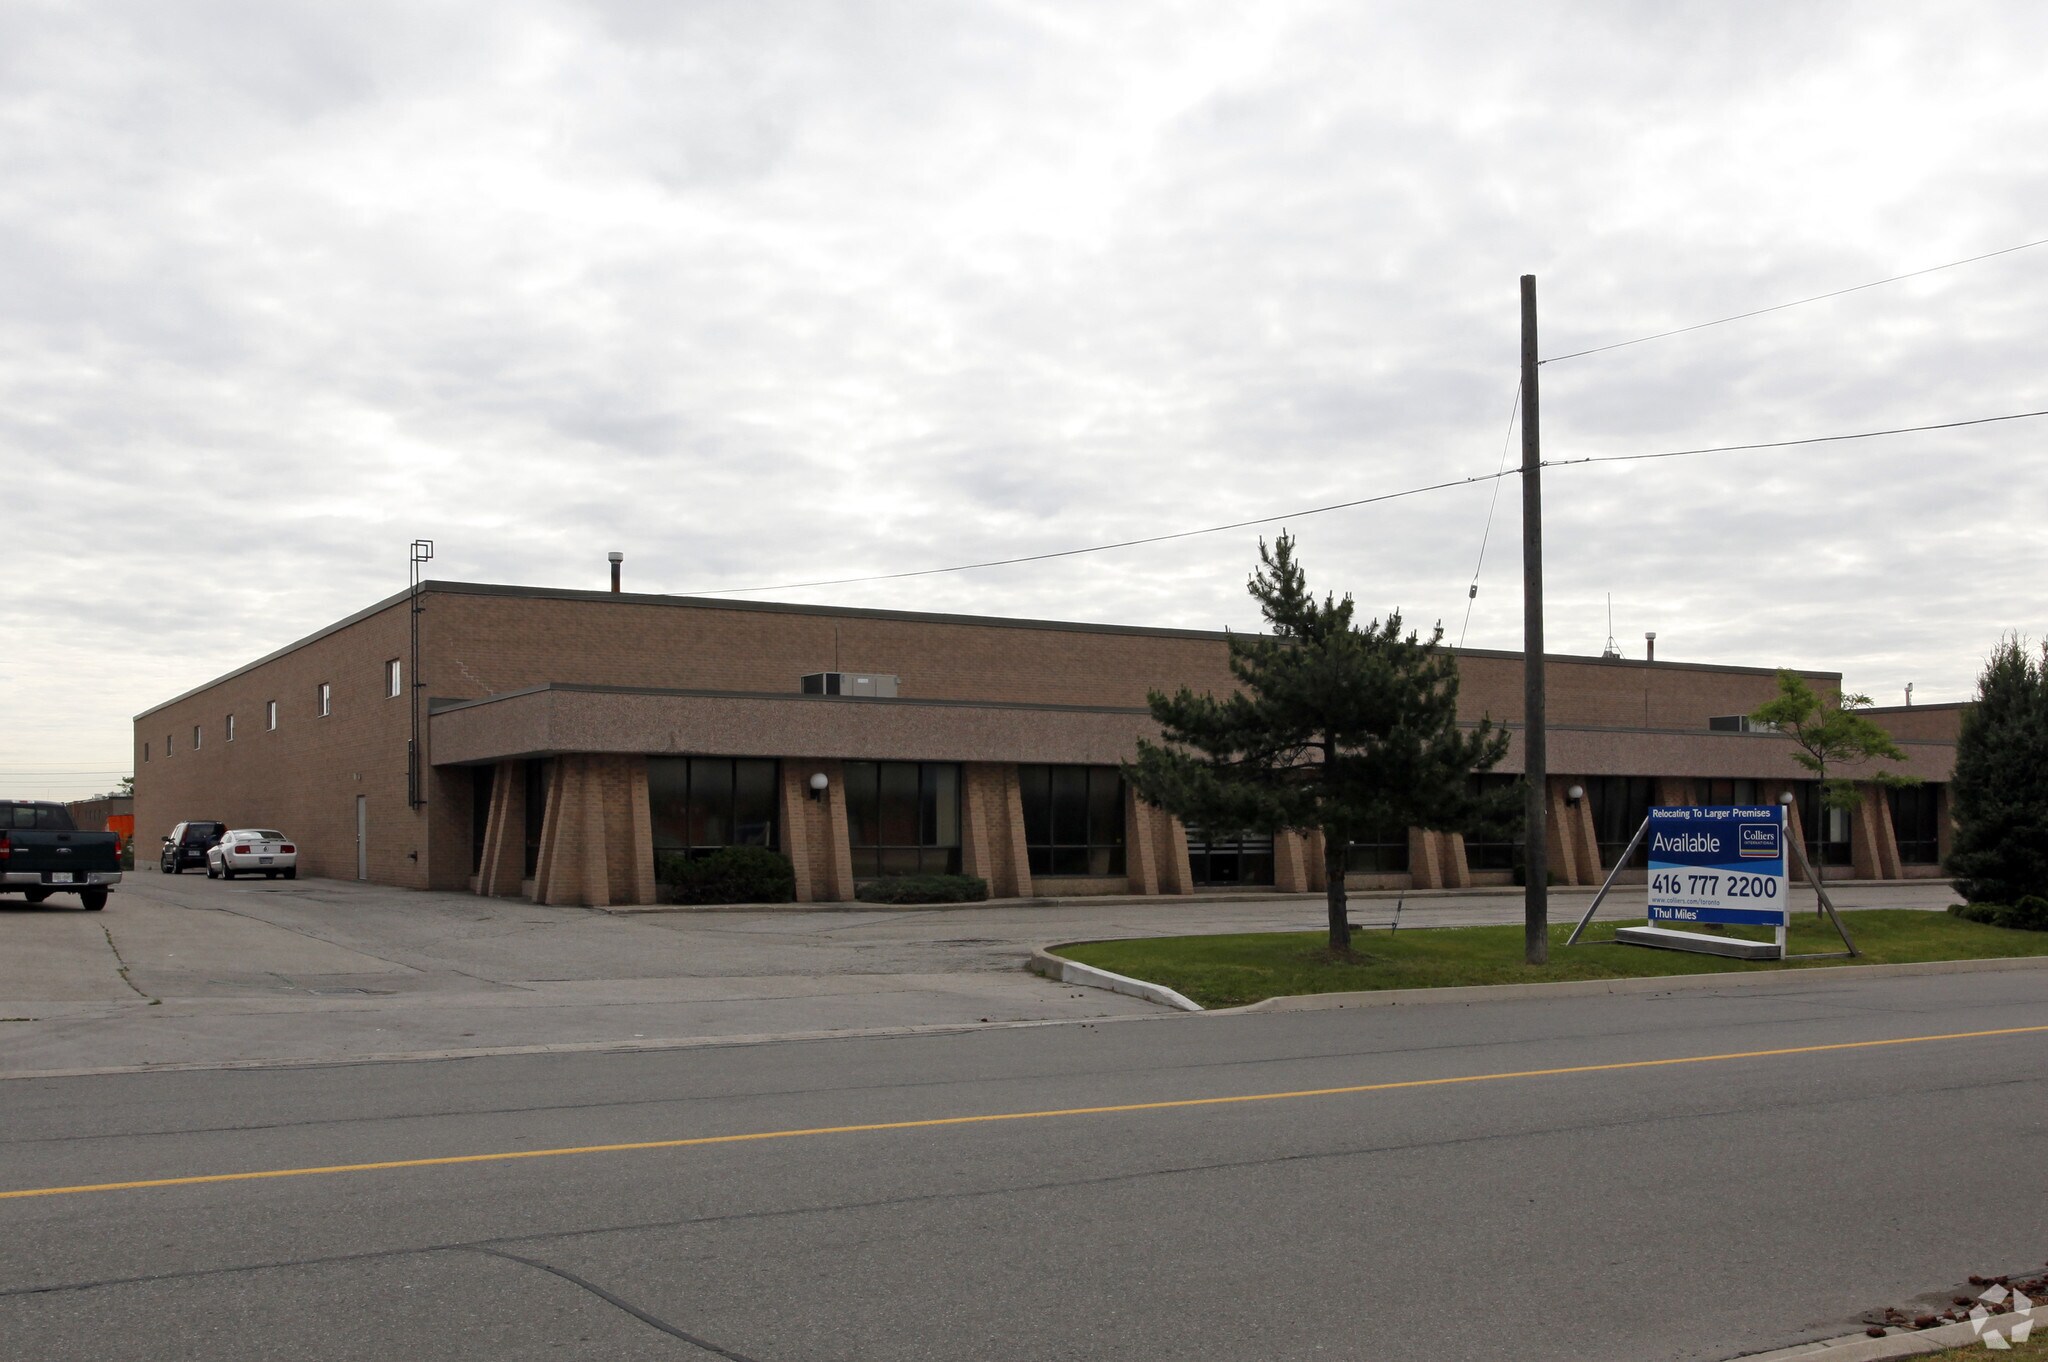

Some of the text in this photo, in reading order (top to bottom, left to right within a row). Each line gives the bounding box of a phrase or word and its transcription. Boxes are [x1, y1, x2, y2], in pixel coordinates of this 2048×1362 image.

[1652, 809, 1771, 820] Relocating To Larger Premises
[1743, 830, 1775, 840] Colliers
[1652, 832, 1720, 853] Available
[1652, 873, 1777, 898] 416 777 2200
[1652, 897, 1720, 906] www.colliers.com/toronto
[1653, 907, 1672, 919] Thul
